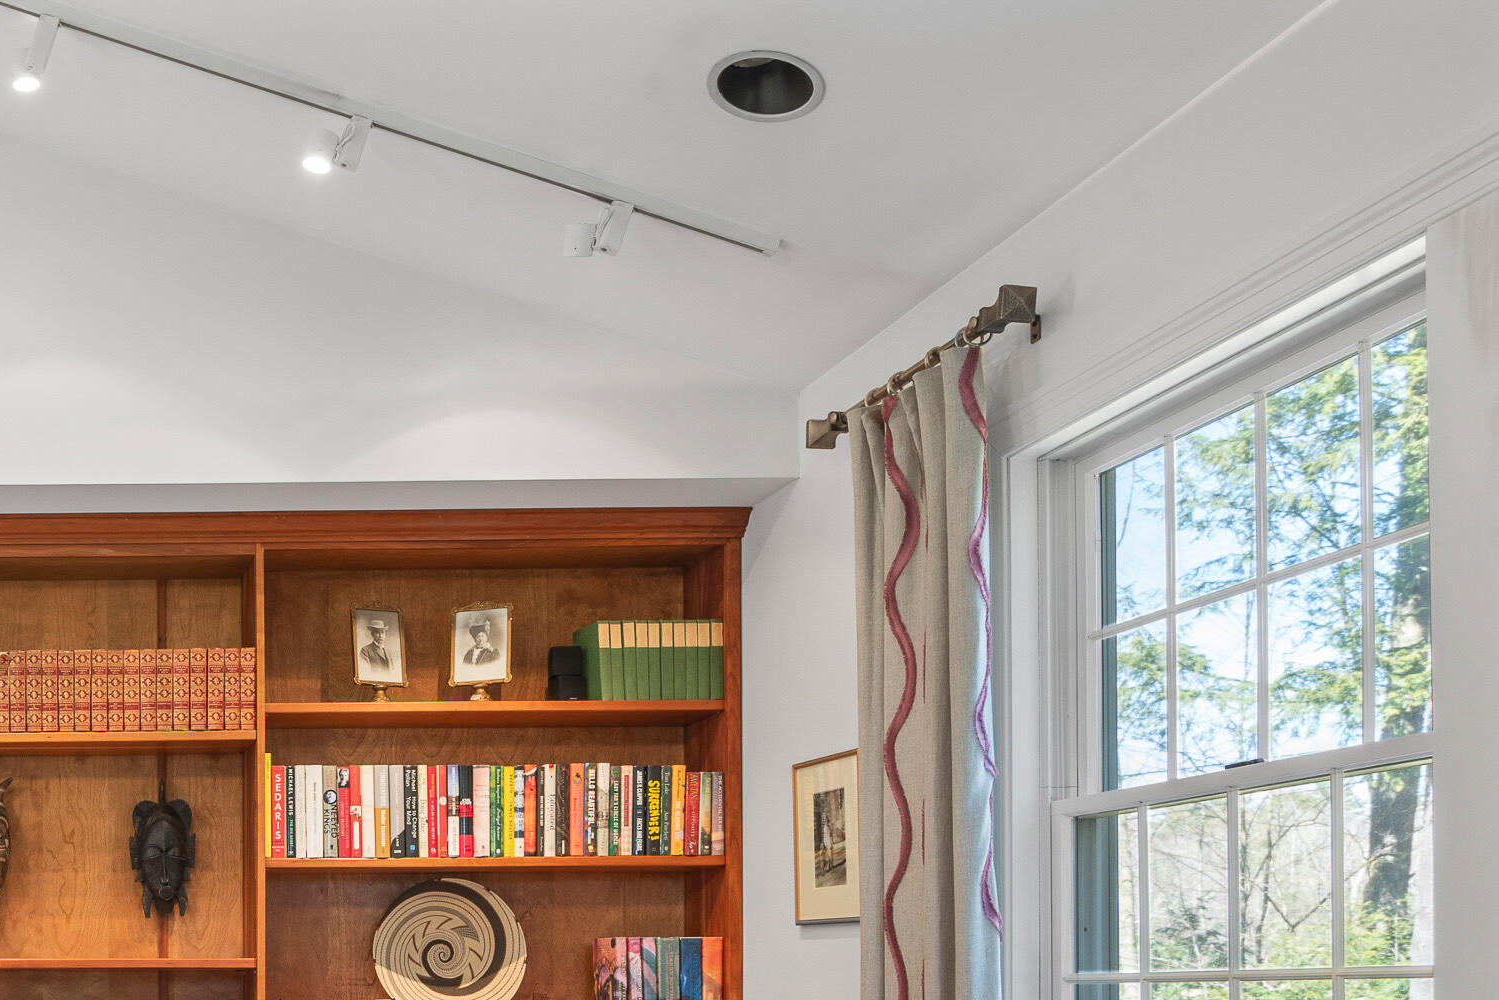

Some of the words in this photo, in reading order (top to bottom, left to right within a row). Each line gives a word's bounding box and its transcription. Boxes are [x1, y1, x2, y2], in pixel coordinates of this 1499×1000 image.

[588, 769, 596, 789] HELLO
[274, 774, 282, 840] SEDARIS
[588, 791, 596, 825] BEAUTIFUL
